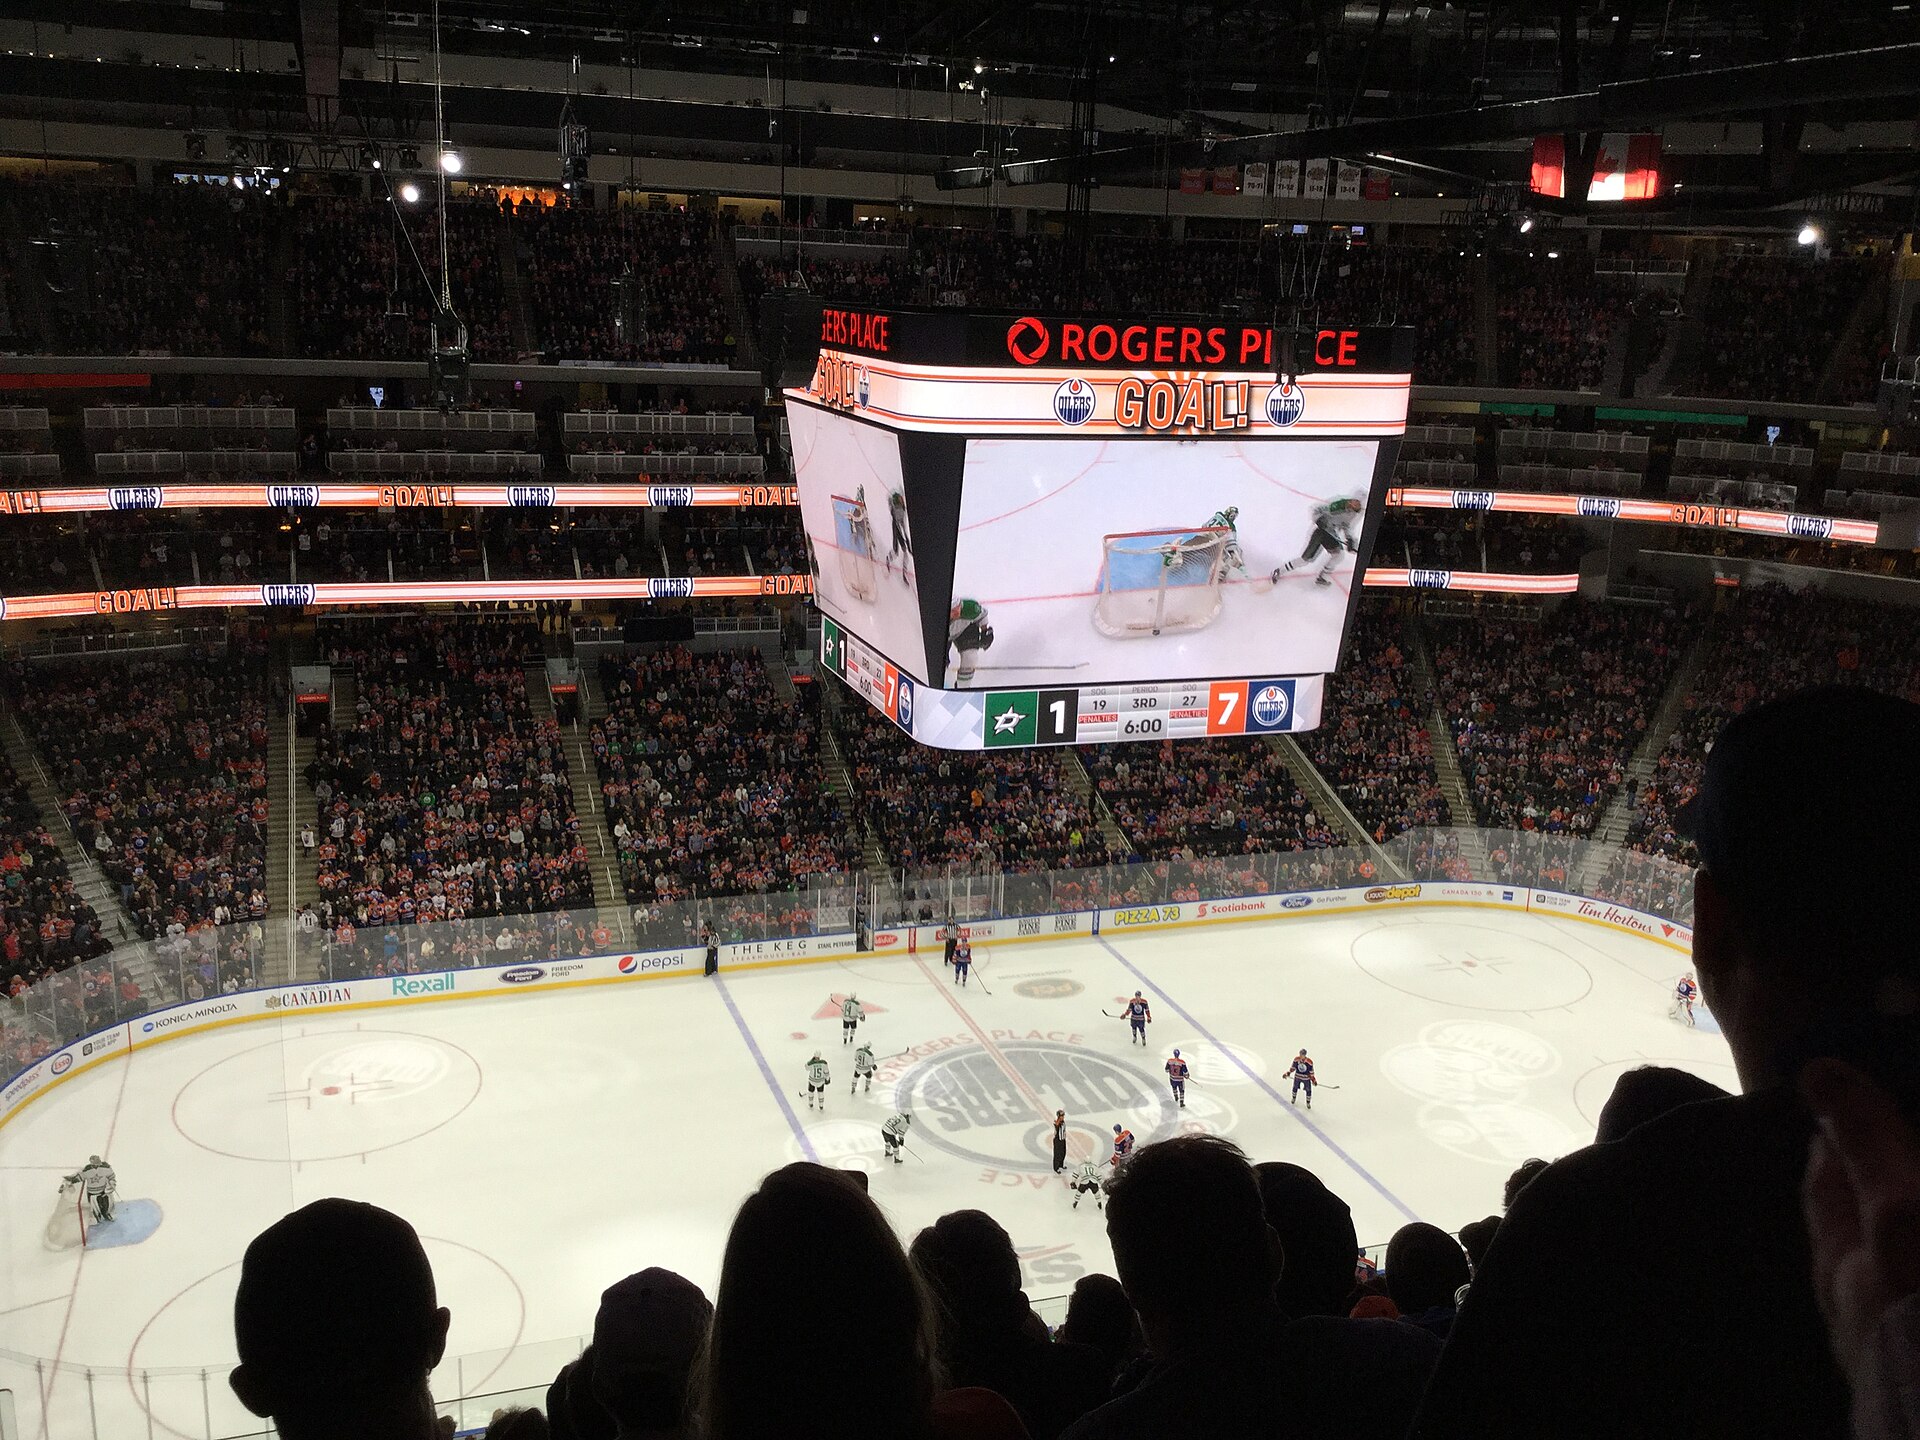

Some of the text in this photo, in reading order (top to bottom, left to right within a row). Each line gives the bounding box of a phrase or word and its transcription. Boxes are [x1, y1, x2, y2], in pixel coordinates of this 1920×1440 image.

[850, 312, 888, 352] PLACE
[1062, 324, 1226, 363] ROGERS
[1115, 377, 1251, 431] GOAL!
[114, 487, 156, 509] OILERS
[273, 487, 313, 507] OILERS
[379, 486, 454, 507] GOAL!
[512, 486, 549, 507] OILERS
[653, 486, 688, 507] OILERS
[1457, 490, 1491, 511] OILERS
[1582, 497, 1617, 519] OILERS
[1670, 503, 1738, 528] GOAL!
[1790, 515, 1828, 538] OILERS
[653, 577, 688, 597] OILERS
[1413, 569, 1447, 589] OILERS
[95, 588, 177, 614] GOAL!
[269, 585, 309, 605] OILERS
[840, 639, 845, 670] 1
[886, 675, 895, 708] 7
[1132, 685, 1158, 693] PERIOD
[1182, 684, 1197, 692] SOG
[1092, 699, 1106, 711] 19
[1132, 697, 1157, 708] 3RD
[1182, 695, 1197, 706] 27
[1218, 692, 1239, 725] 7
[1256, 700, 1284, 714] OILERS
[1049, 700, 1065, 735] 1
[1079, 714, 1117, 723] PENALTIES
[1169, 709, 1207, 719] PENALTIES
[1124, 719, 1162, 734] 6:00
[1285, 898, 1307, 907] Ford
[1386, 885, 1421, 900] depot
[1114, 908, 1160, 926] PIZZA
[1162, 906, 1181, 921] 73
[1211, 901, 1266, 914] Scotiabank
[1578, 900, 1653, 934] Tim Hortons
[1018, 922, 1040, 931] PINE
[1055, 919, 1076, 928] PINE
[731, 940, 807, 955] THE KEG
[551, 964, 584, 972] FREEDOM
[641, 953, 684, 971] pepsi
[392, 972, 455, 996] Rexall
[282, 988, 351, 1007] CANADIAN
[155, 1003, 238, 1029] KONICA MINOLTA
[990, 1029, 1084, 1045] PLACE
